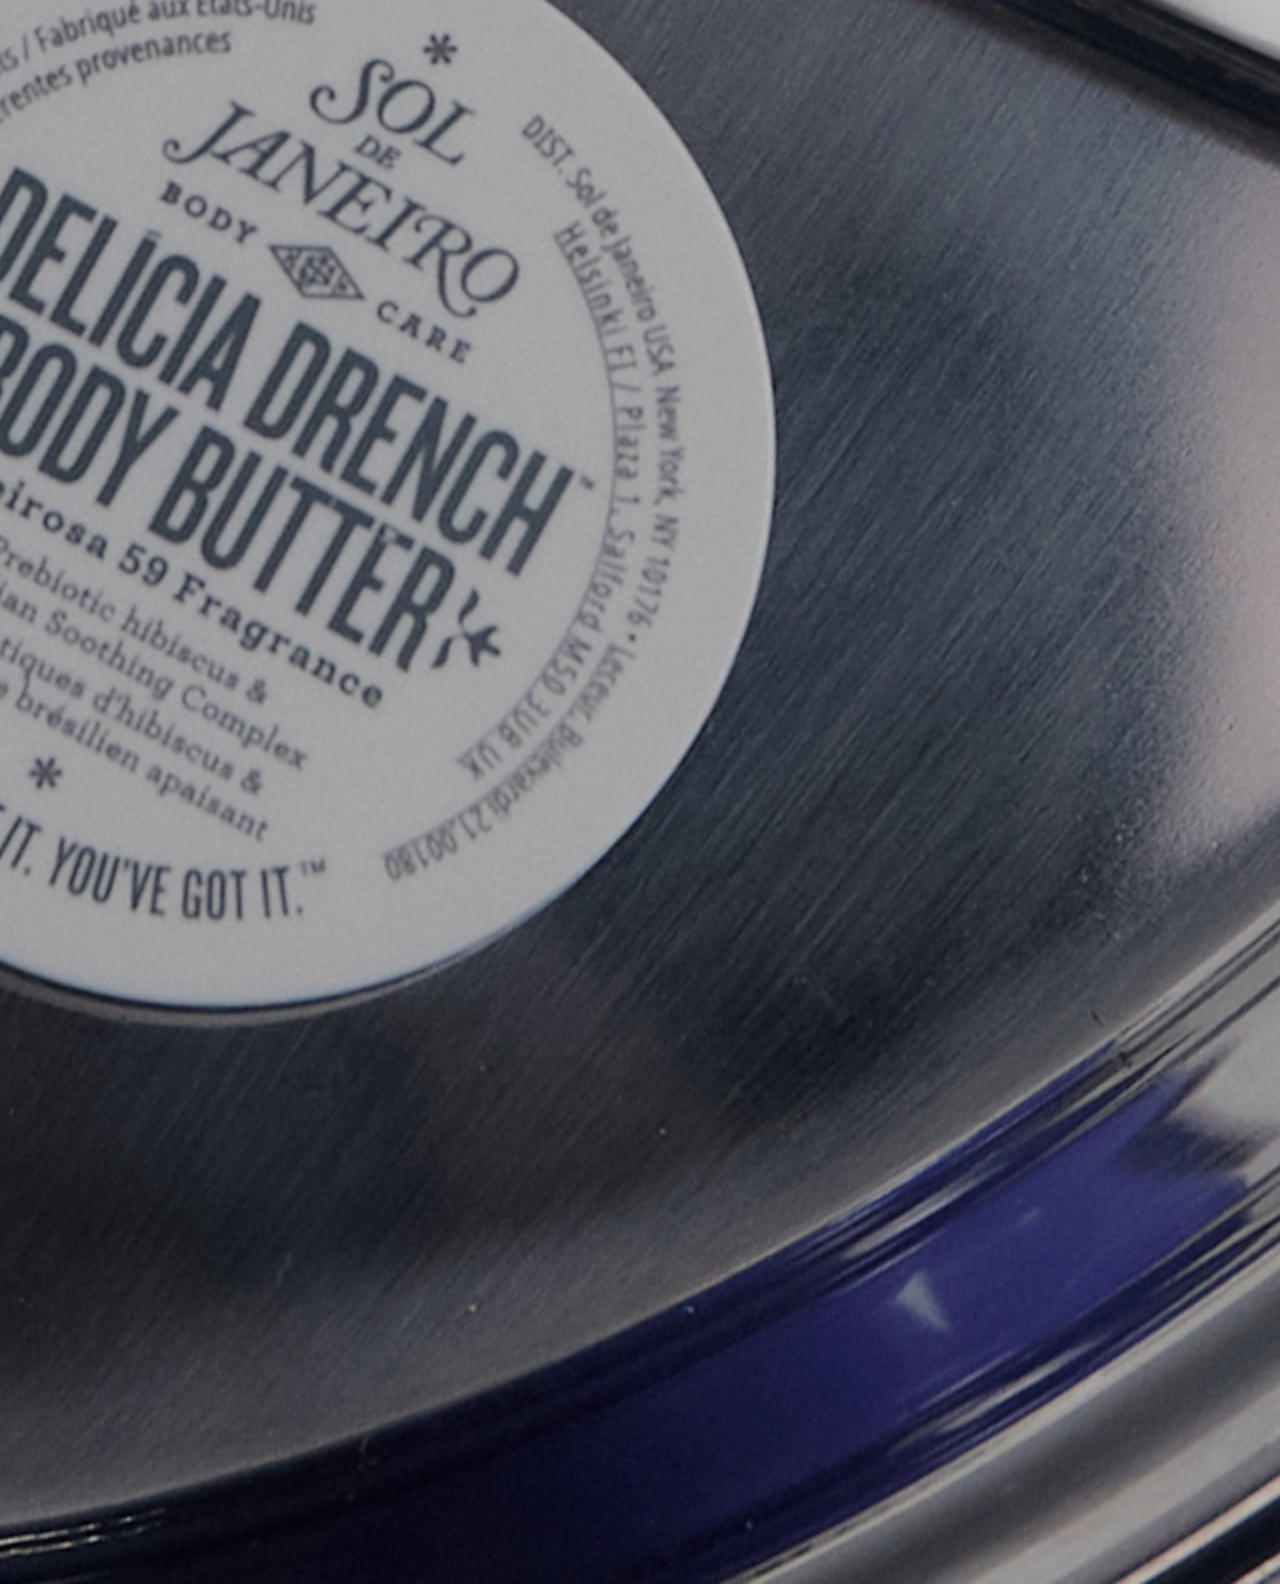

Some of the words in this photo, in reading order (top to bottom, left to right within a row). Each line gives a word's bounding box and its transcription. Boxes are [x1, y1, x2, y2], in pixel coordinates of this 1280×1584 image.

[74, 31, 232, 87] provenances
[310, 58, 475, 166] SOL
[162, 99, 520, 319] JANEIRO
[354, 134, 401, 171] DE
[159, 180, 258, 245] BODY
[375, 300, 472, 365] CARE
[117, 542, 169, 587] 59
[172, 571, 383, 709] Fragrance
[147, 424, 456, 673] BUTTER
[44, 609, 175, 702] Soothing
[181, 684, 308, 771] Complex
[119, 605, 240, 691] hibiscus
[14, 686, 140, 773] brésilien
[145, 765, 269, 842] apaisant
[48, 836, 172, 917] YOU'VE
[181, 868, 247, 921] GOT
